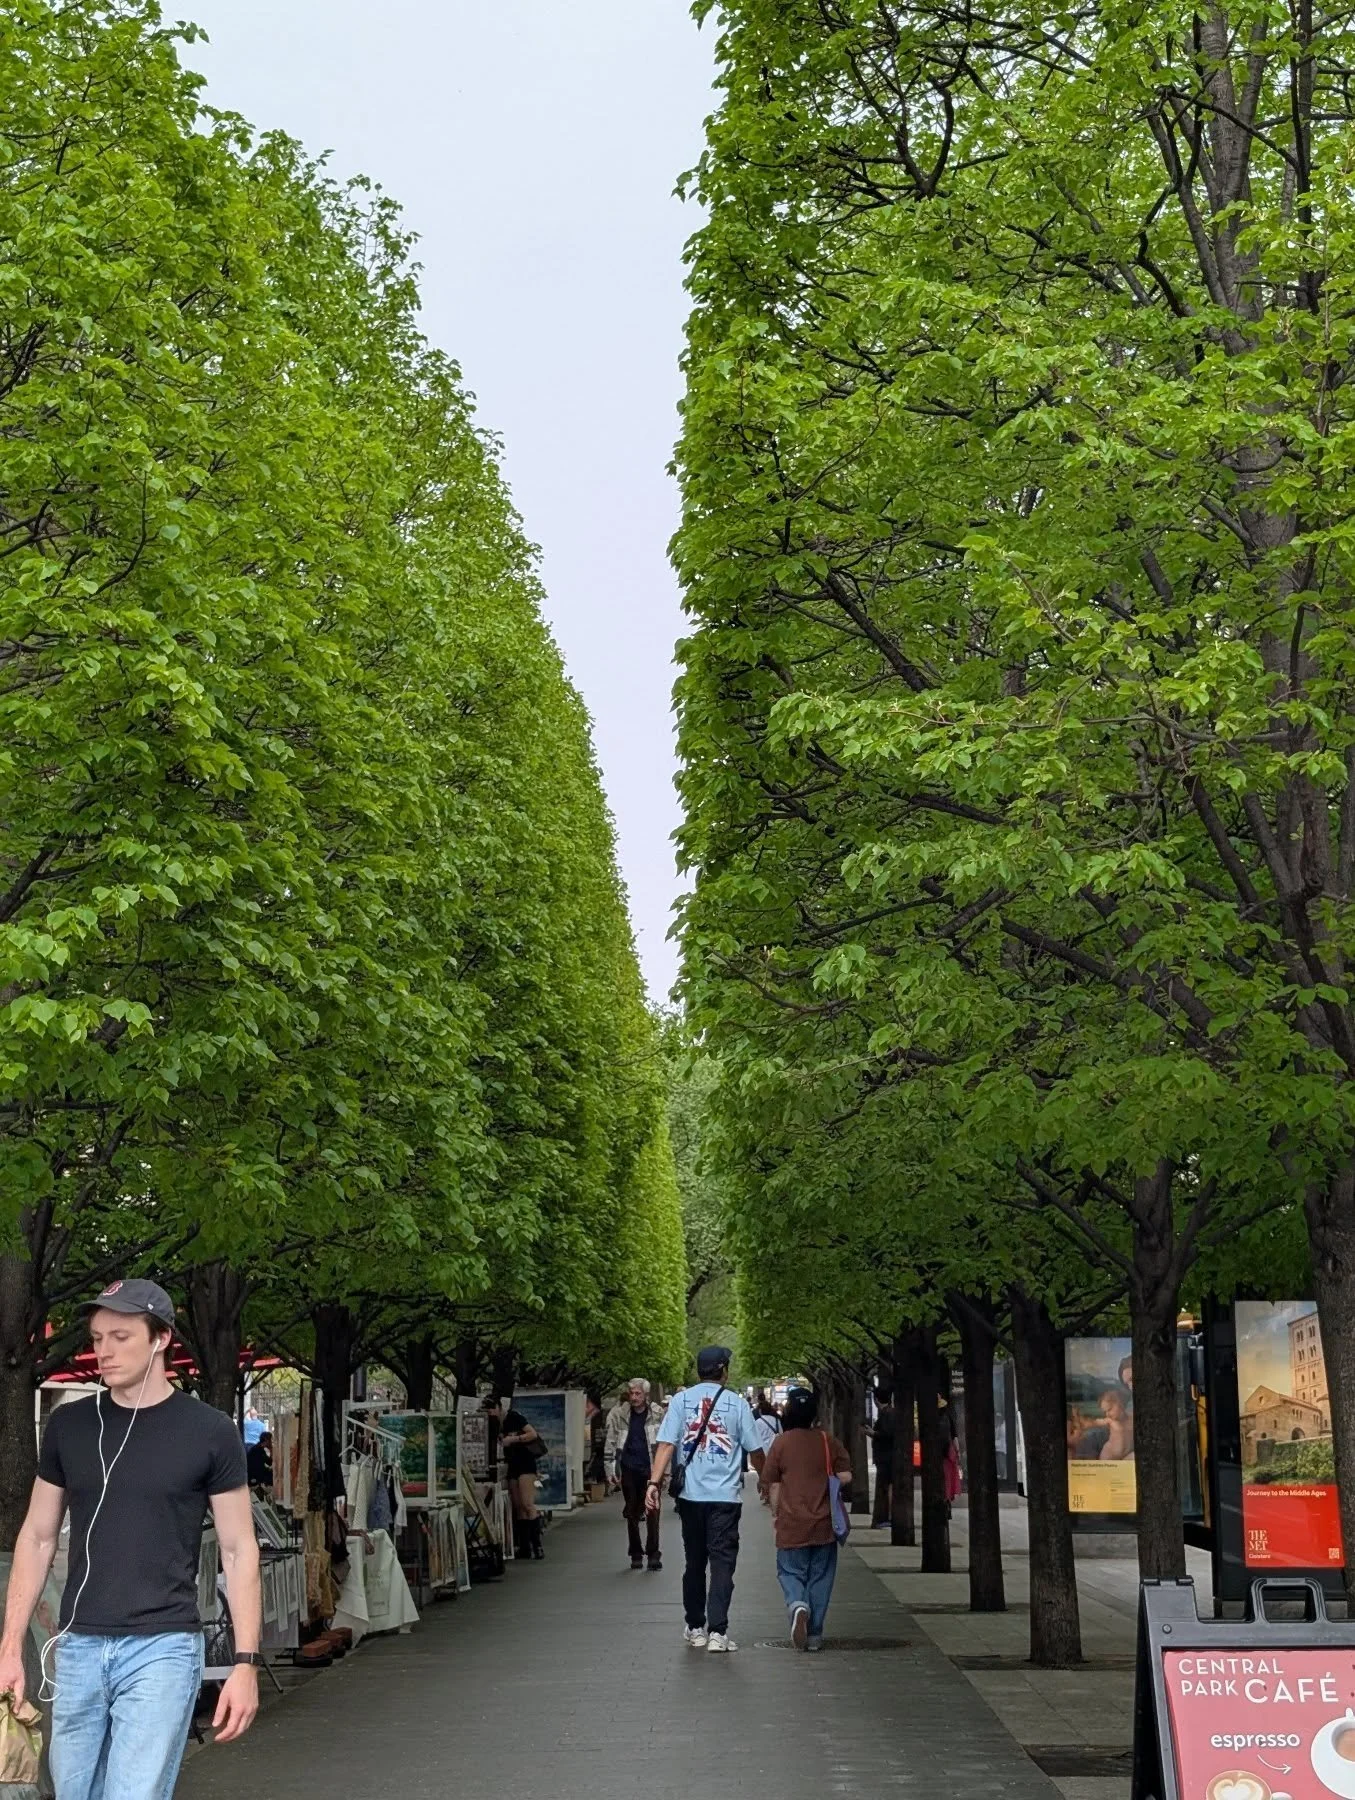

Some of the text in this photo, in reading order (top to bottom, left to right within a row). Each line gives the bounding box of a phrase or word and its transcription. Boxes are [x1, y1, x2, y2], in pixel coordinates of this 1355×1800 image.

[1246, 1489, 1270, 1497] Journey
[1248, 1530, 1267, 1540] THE
[1249, 1541, 1268, 1550] MET
[1178, 1658, 1284, 1675] CENTRAL
[1181, 1671, 1339, 1704] PARK CAFÉ
[1210, 1734, 1301, 1751] espresso
